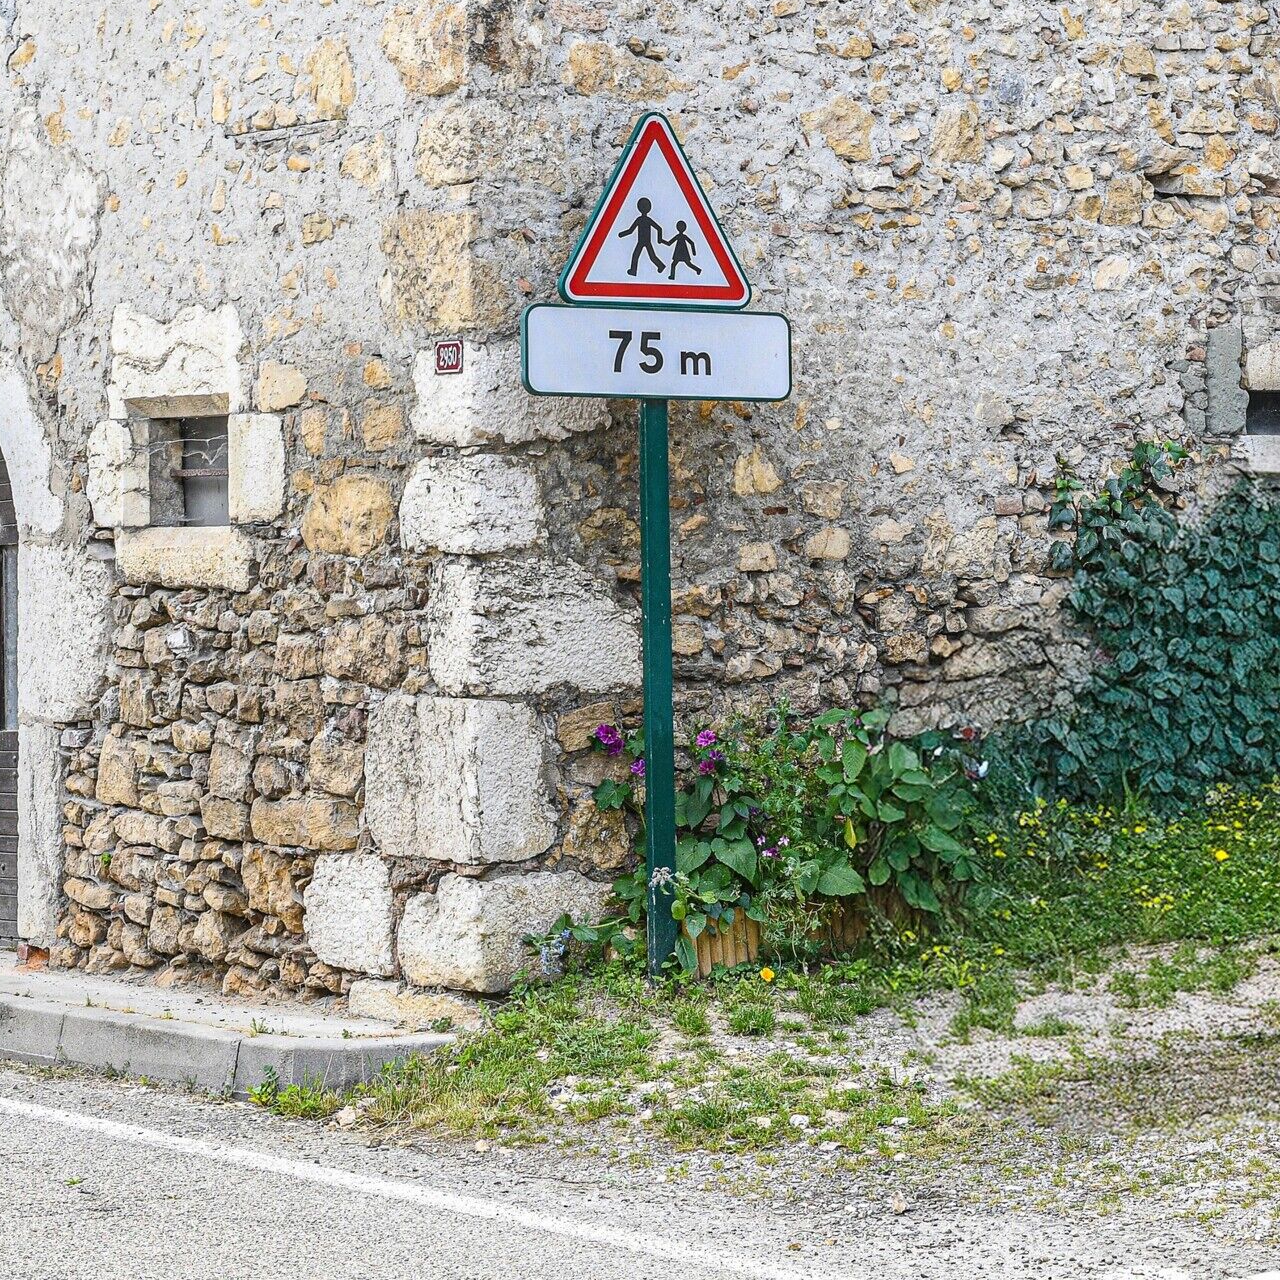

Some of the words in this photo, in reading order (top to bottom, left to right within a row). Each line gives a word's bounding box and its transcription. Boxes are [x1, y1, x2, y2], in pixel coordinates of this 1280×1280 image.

[439, 345, 458, 369] 2950
[608, 330, 664, 374] 75
[680, 350, 712, 376] m
